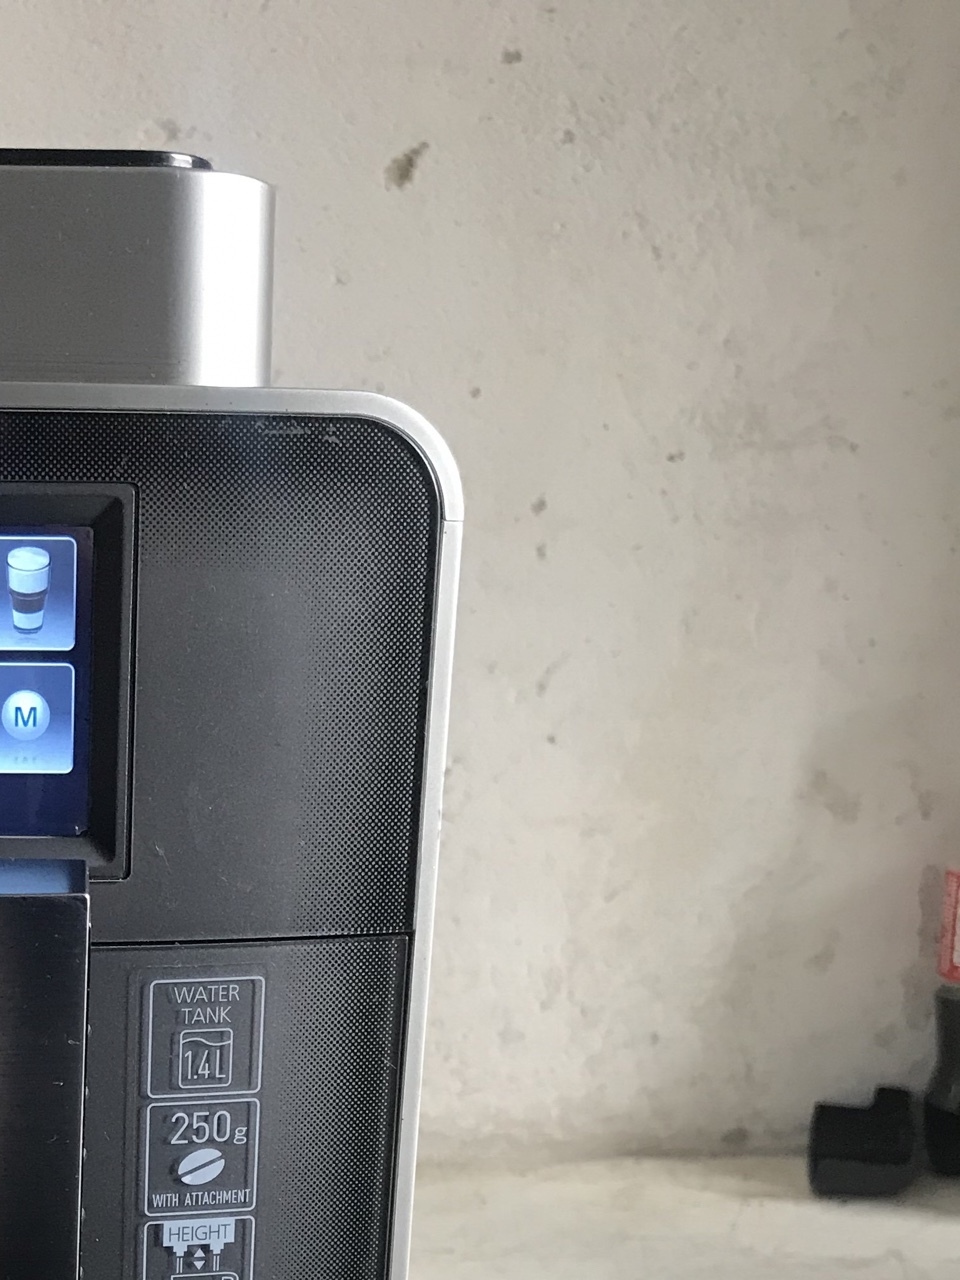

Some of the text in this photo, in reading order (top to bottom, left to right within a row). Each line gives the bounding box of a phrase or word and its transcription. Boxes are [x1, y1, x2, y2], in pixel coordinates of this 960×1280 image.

[14, 706, 37, 728] M
[174, 984, 240, 1004] WATER
[181, 1006, 232, 1025] TANK
[152, 1188, 251, 1208] WITH ATTACHMENT
[168, 1223, 231, 1243] HEIGHT
